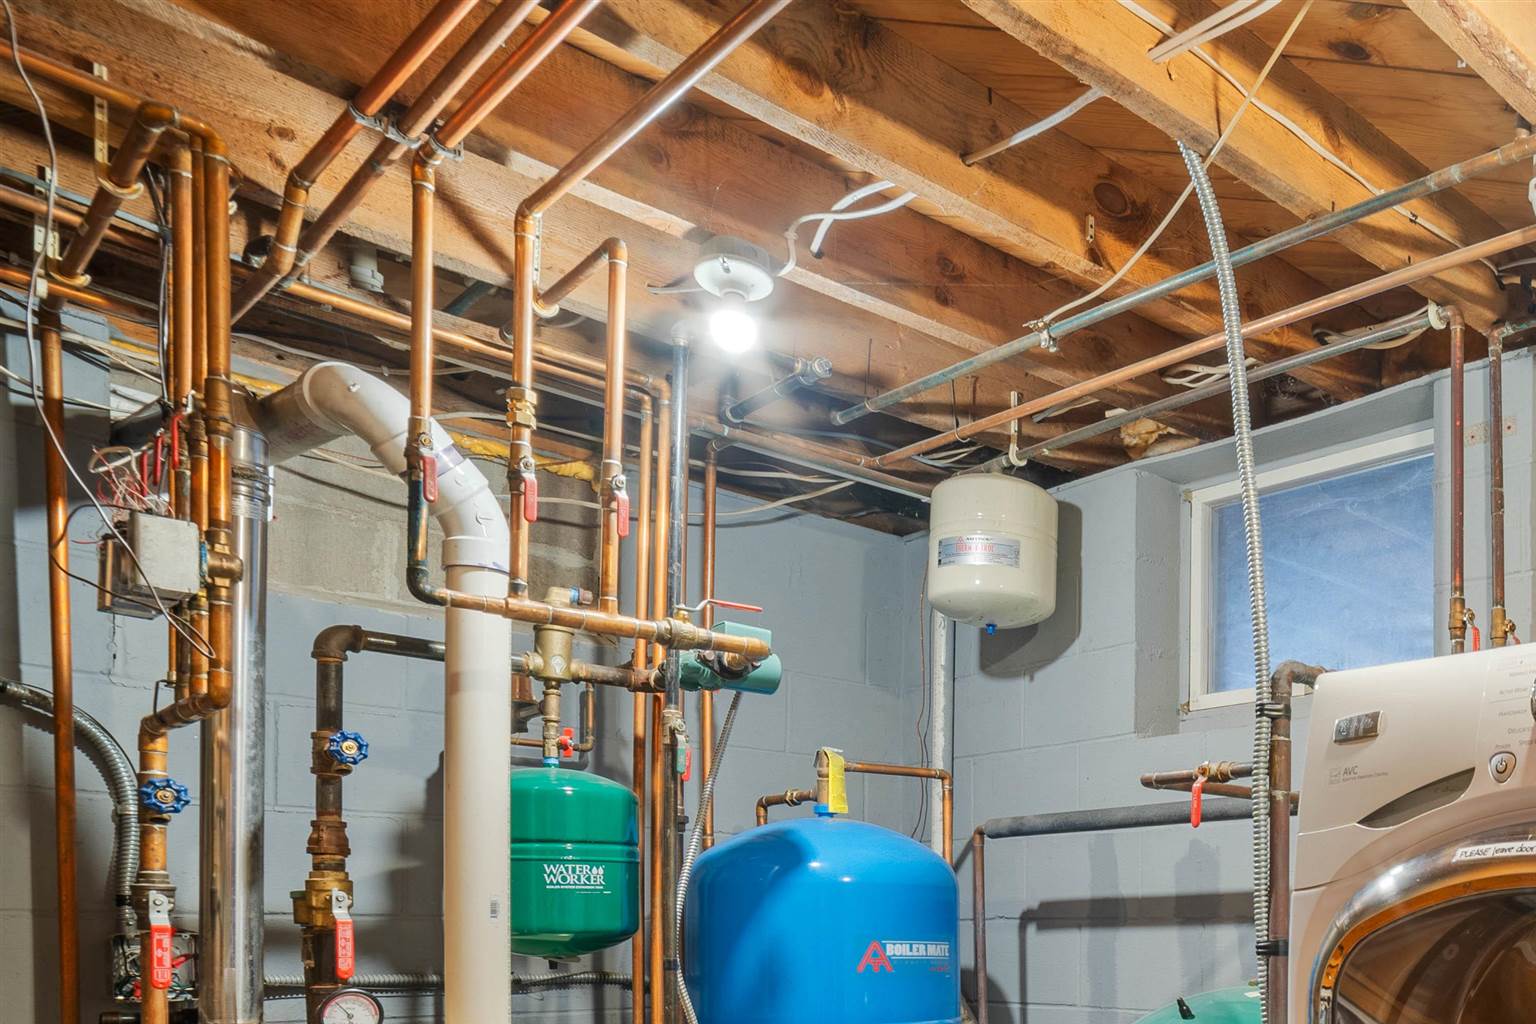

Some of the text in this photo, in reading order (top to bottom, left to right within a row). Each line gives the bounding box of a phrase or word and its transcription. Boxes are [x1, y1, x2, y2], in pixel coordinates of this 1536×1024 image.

[1342, 765, 1359, 776] AVC
[1460, 847, 1491, 858] PLEASE
[1516, 843, 1536, 853] door
[543, 863, 591, 875] WATER
[543, 873, 606, 885] WORKER
[886, 943, 926, 957] BOILER
[927, 943, 950, 957] MATE
